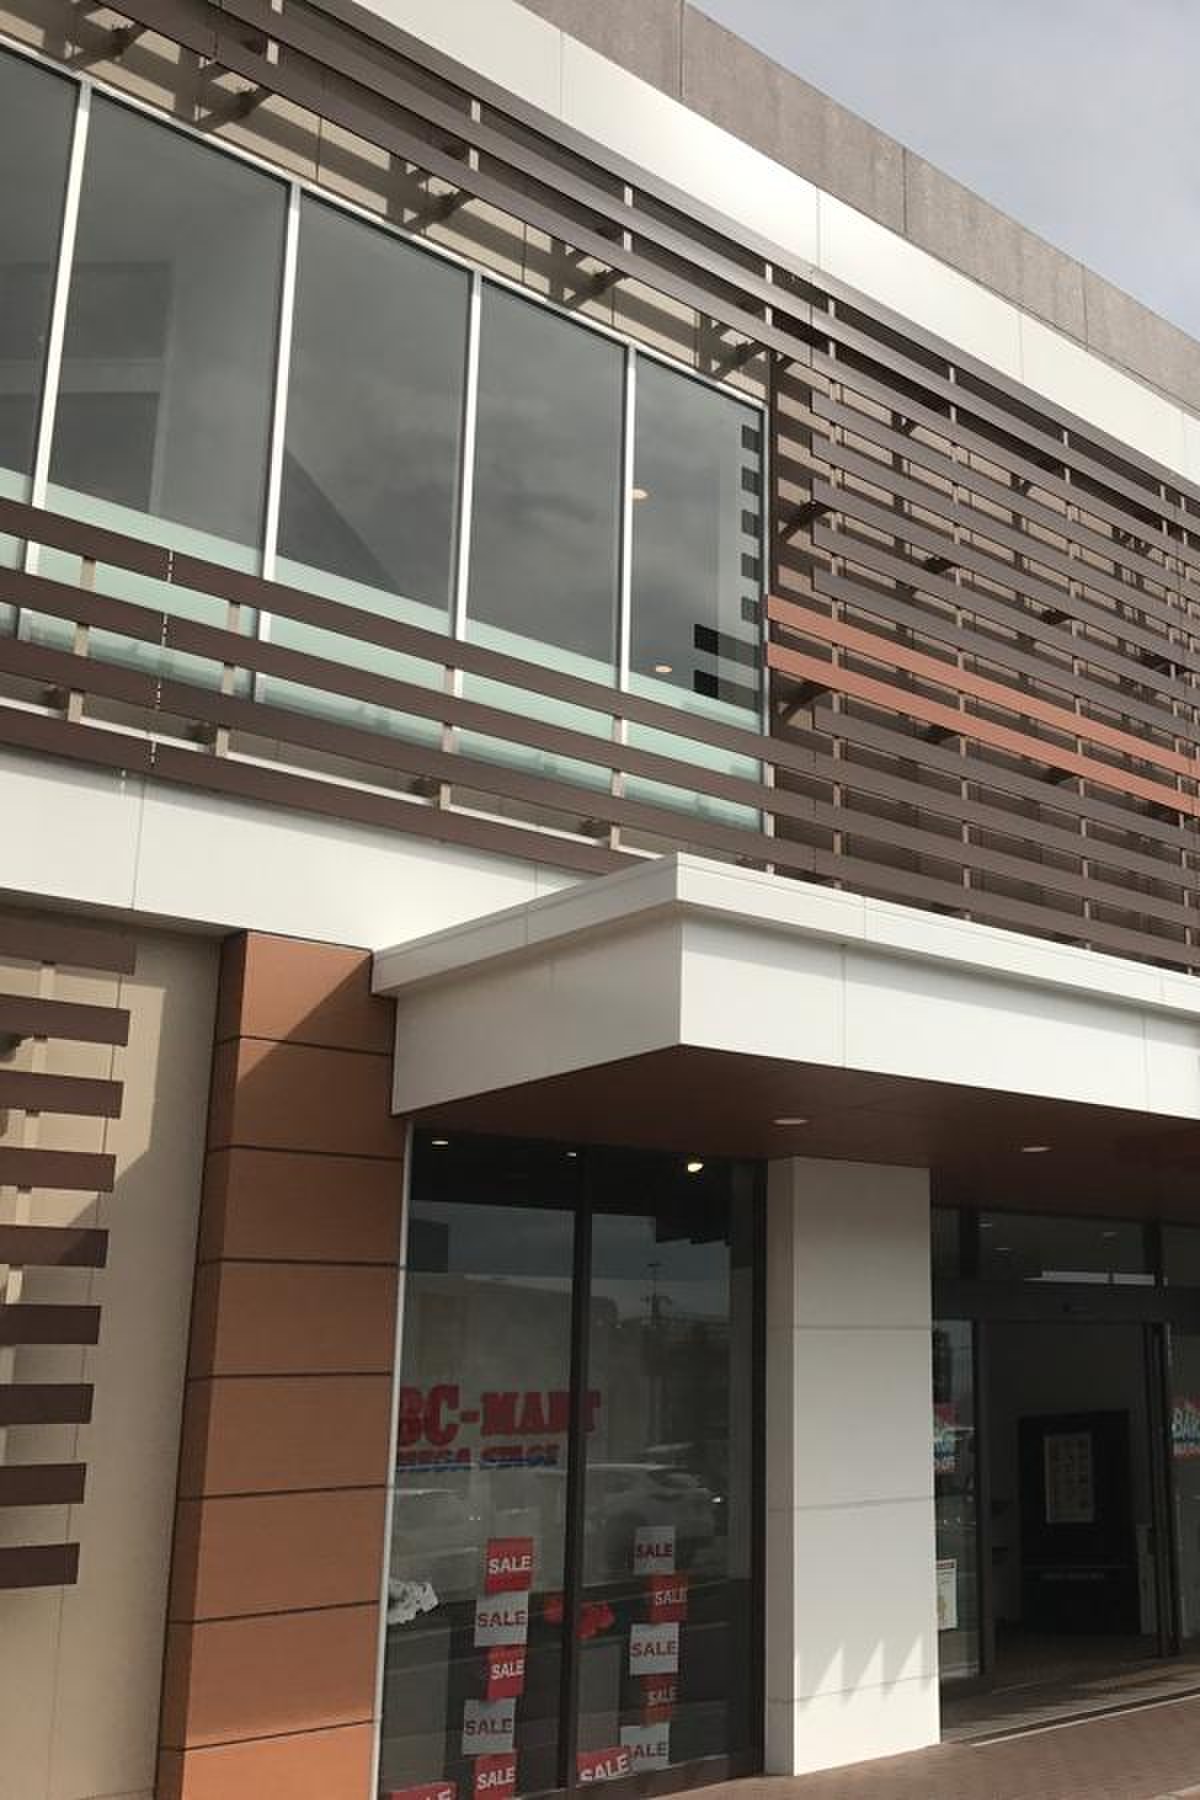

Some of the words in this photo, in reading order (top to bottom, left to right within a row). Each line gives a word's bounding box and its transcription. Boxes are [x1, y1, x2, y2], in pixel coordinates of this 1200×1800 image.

[634, 1542, 674, 1560] SALE
[487, 1555, 532, 1575] SALE
[654, 1586, 688, 1606] SALE
[477, 1611, 528, 1628] SALE
[630, 1641, 679, 1658] SALE
[490, 1660, 526, 1680] SALE
[463, 1717, 513, 1736] SALE
[579, 1753, 630, 1782] SALE
[476, 1766, 516, 1791] SALE
